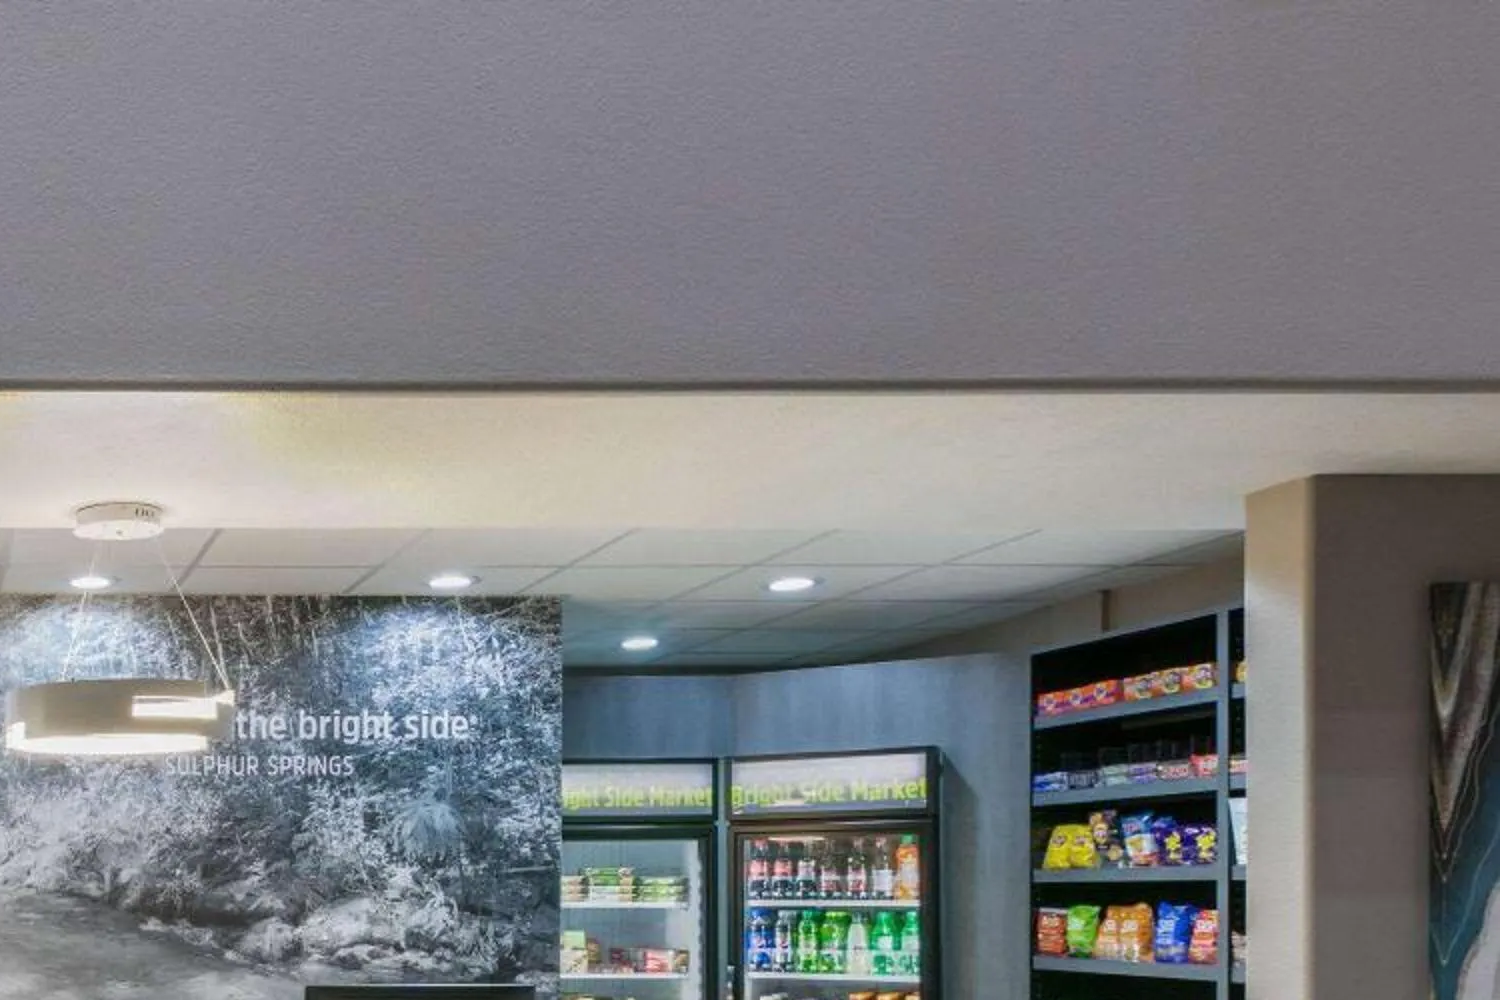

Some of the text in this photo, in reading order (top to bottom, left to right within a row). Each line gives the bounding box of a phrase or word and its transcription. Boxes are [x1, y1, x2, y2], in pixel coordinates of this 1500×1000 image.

[235, 709, 288, 740] the
[301, 709, 393, 744] bright
[165, 754, 354, 776] SULPHUR SPRINGS
[851, 777, 927, 802] Market
